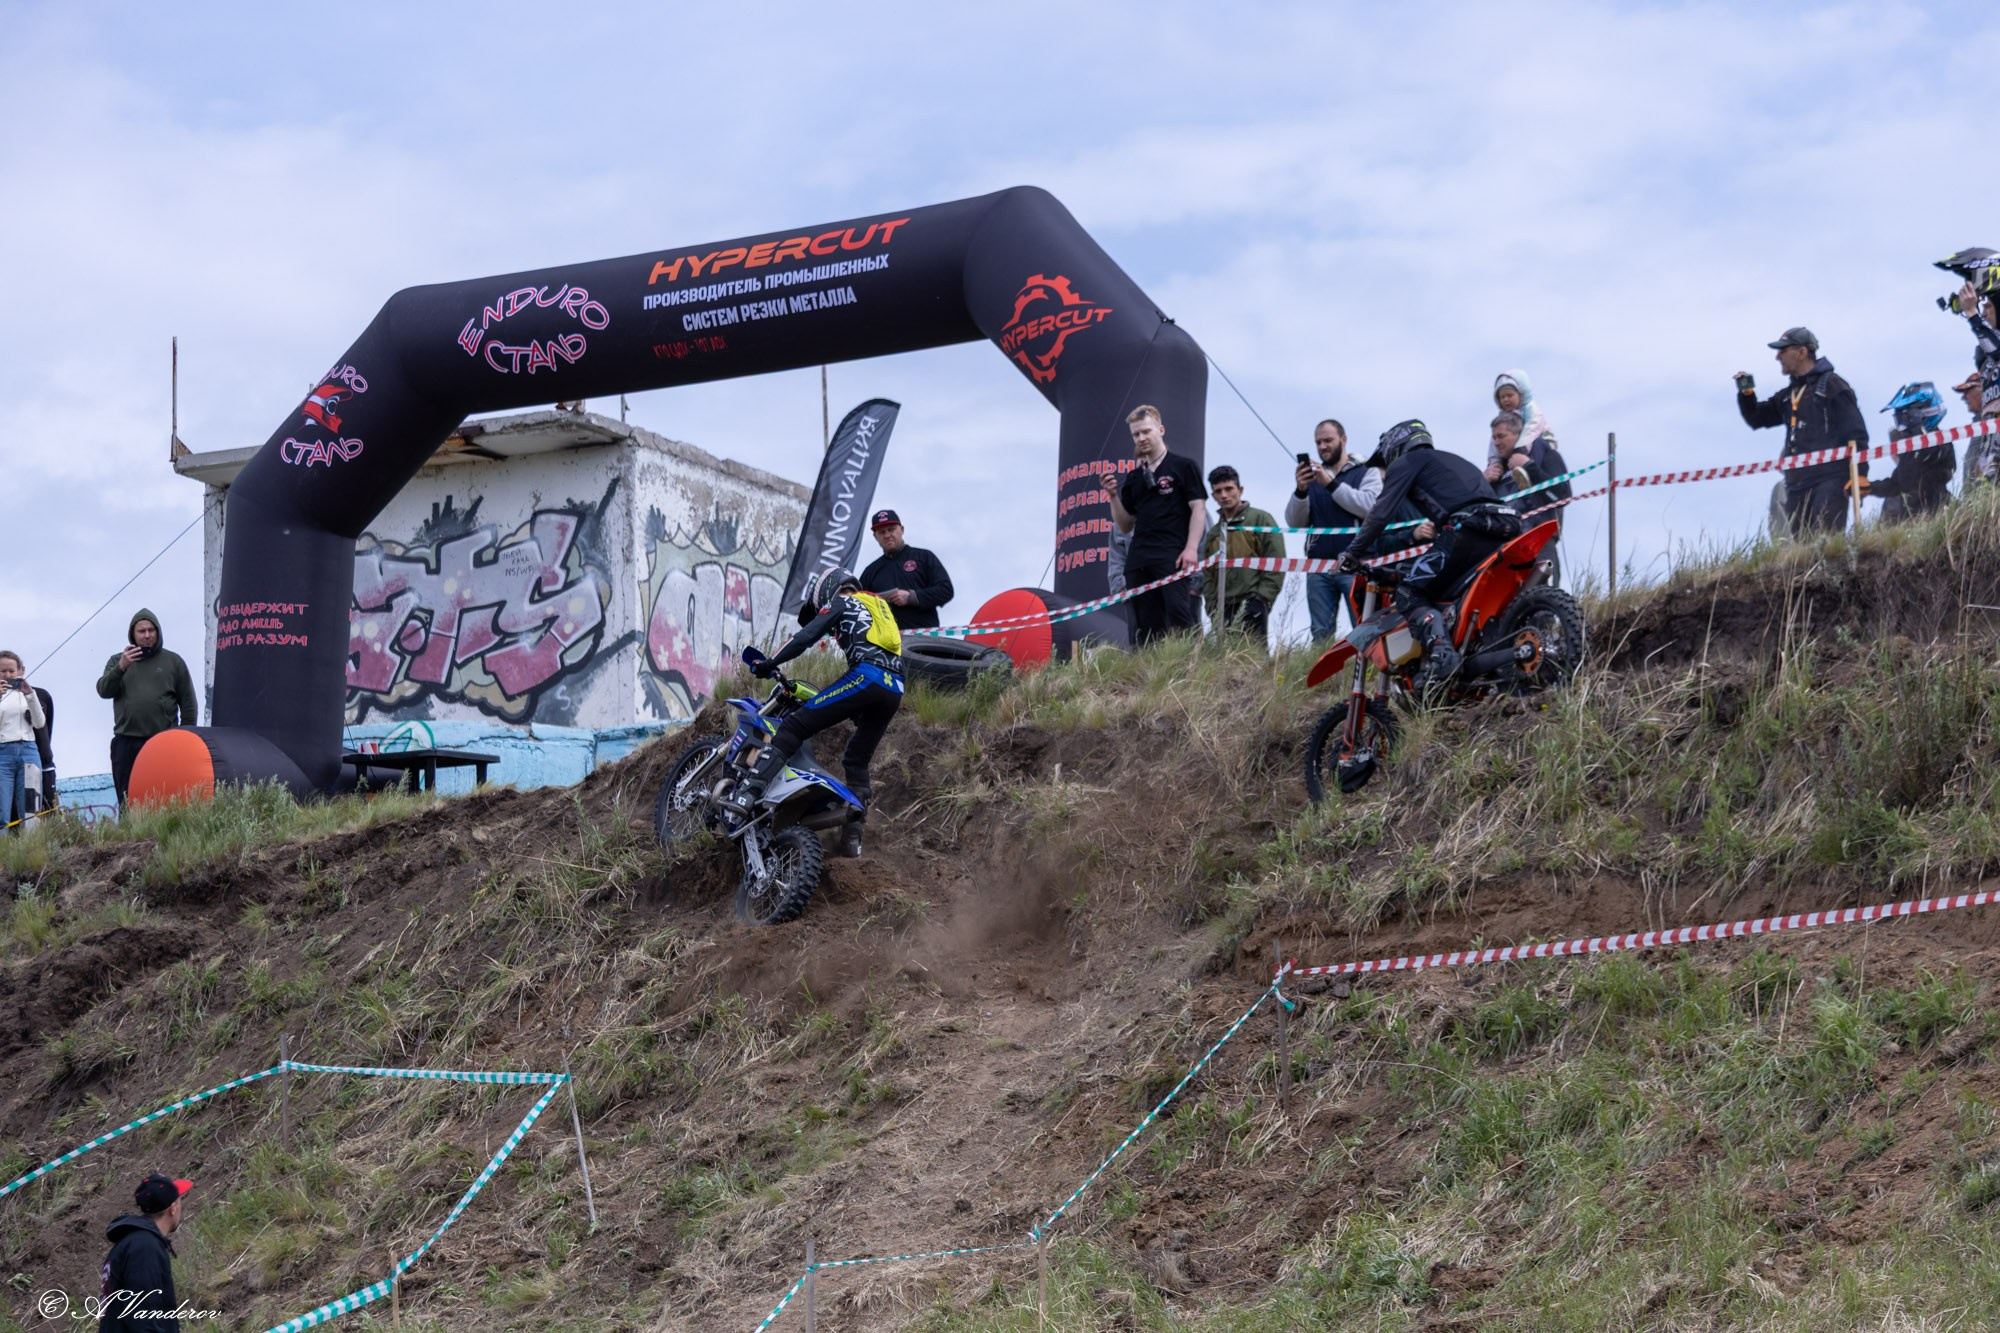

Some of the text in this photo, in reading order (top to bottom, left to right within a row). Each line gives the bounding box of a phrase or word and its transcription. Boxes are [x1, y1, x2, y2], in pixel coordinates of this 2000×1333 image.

[648, 217, 911, 286] HYPERCUT
[643, 253, 889, 310] ПРОИЗВОДИТЕЛЬ ПРОМЫШЛЕННЫХ
[458, 283, 610, 357] ENDURO
[682, 285, 857, 333] СИСТЕМ РЕЗКИ МЕТАЛЛА
[1000, 308, 1114, 354] HYPERCUT
[1056, 547, 1110, 573] будет
[229, 602, 309, 616] ВЫДЕРЖИТ
[241, 617, 284, 630] ЛИШЬ
[245, 633, 308, 647] РАЗУМ
